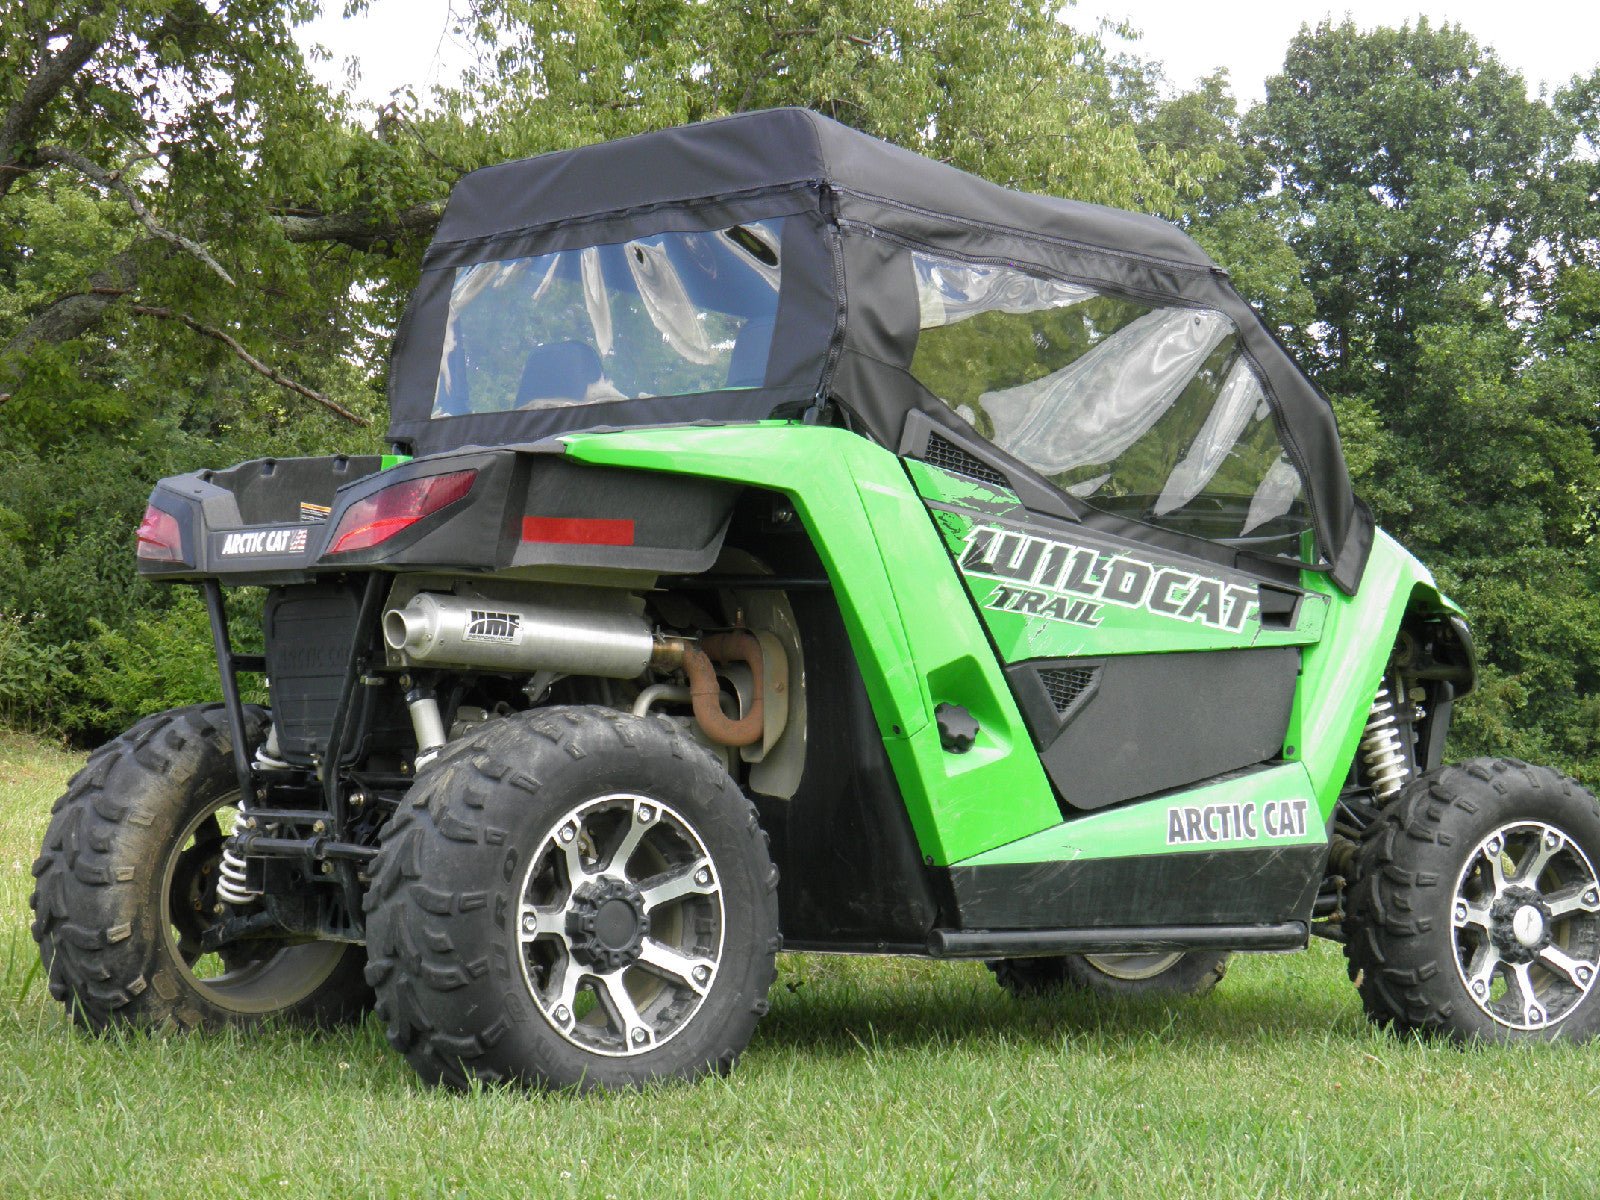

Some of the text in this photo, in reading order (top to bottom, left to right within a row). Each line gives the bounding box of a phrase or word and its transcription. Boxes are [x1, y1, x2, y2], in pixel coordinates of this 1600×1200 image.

[221, 530, 290, 554] ARCTIC CAT
[957, 525, 1259, 633] WILDCAT
[469, 610, 520, 637] HMF
[984, 584, 1105, 628] TRAIL
[1167, 799, 1308, 845] ARCTIC CAT
